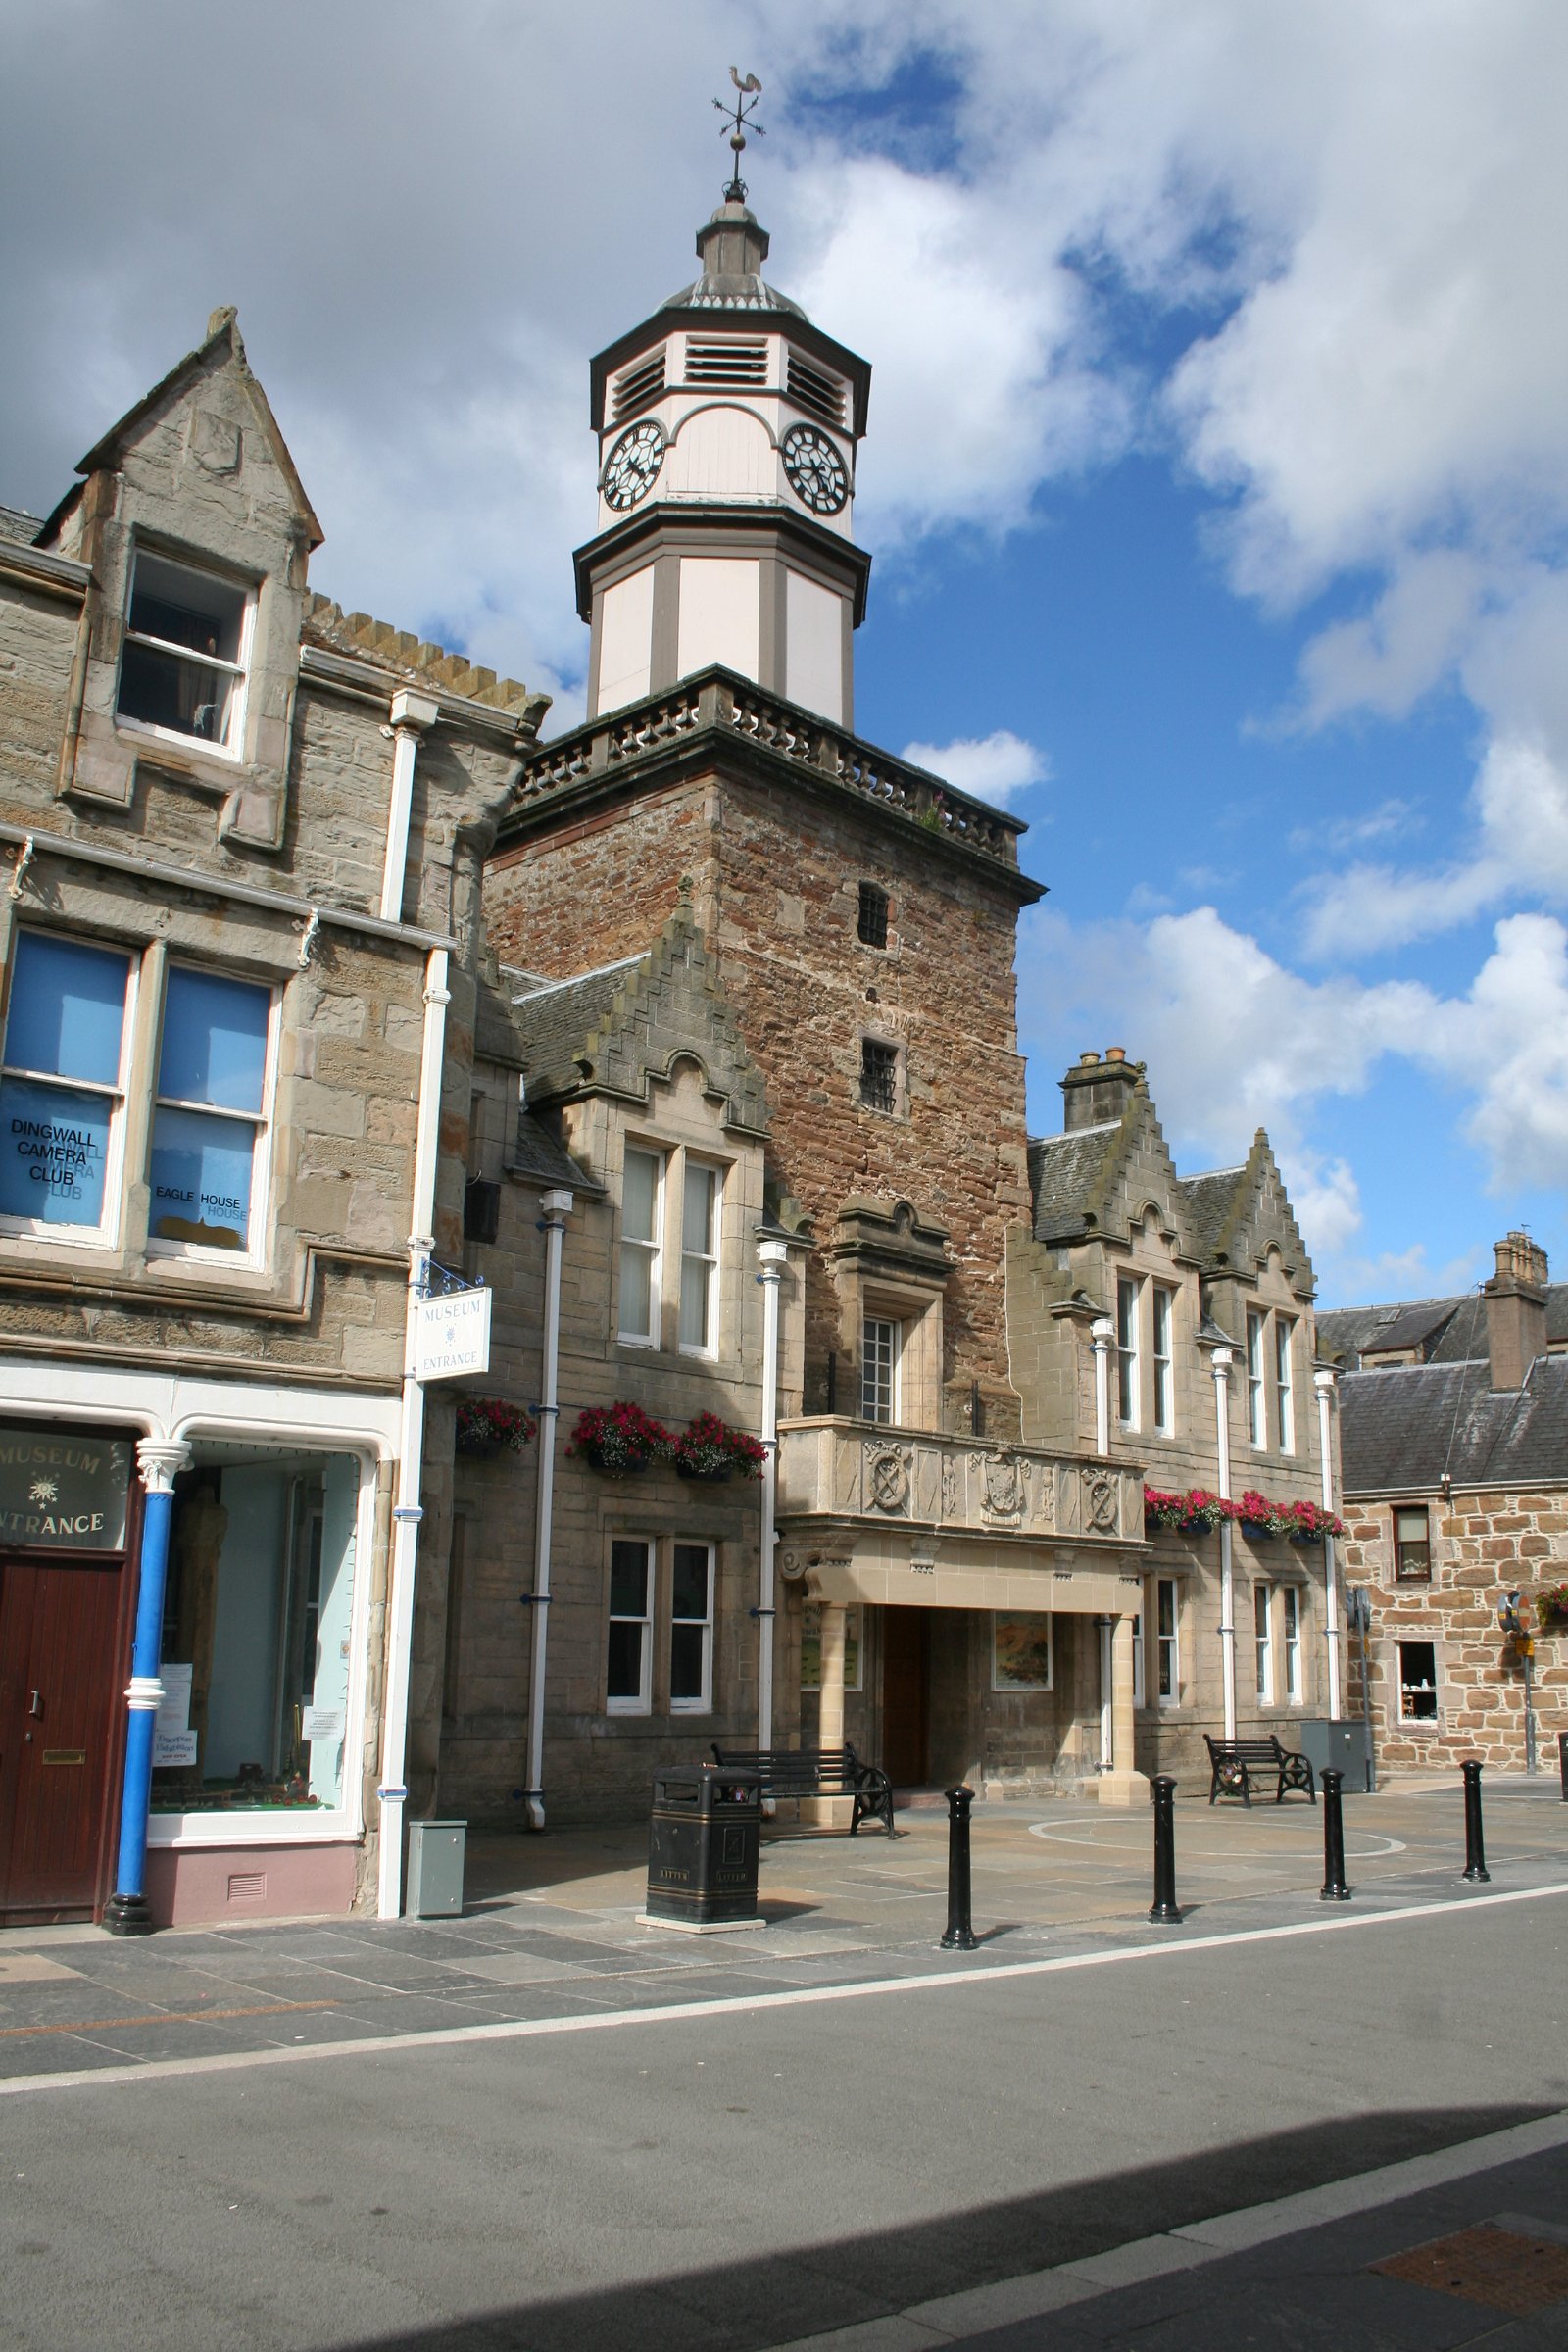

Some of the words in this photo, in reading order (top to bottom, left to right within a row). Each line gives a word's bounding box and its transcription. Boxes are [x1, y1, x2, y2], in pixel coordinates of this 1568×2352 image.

[11, 1119, 96, 1147] DINGWALL
[17, 1141, 87, 1165] CAMERA
[29, 1165, 74, 1186] CLUB
[156, 1186, 195, 1202] EAGLE
[200, 1193, 241, 1209] HOUSE
[425, 1300, 481, 1322] MUSEUM
[423, 1351, 478, 1370] ENTRANCE
